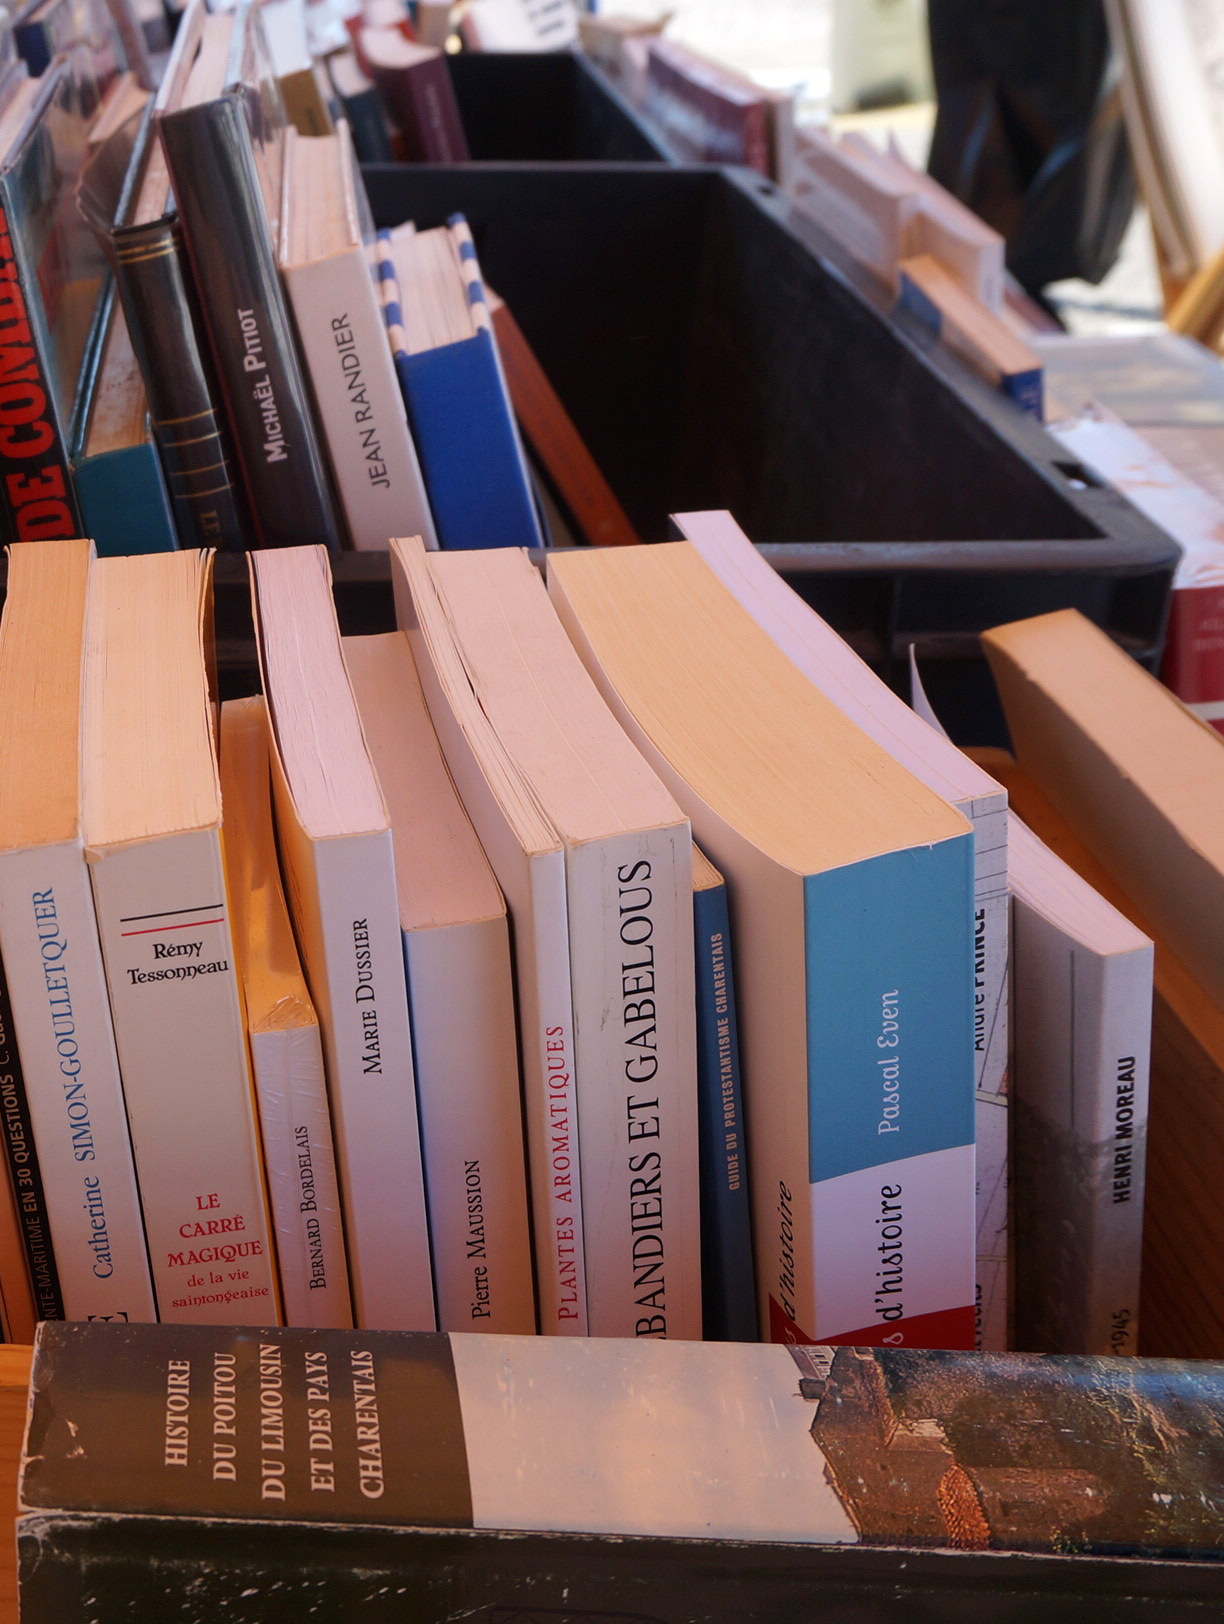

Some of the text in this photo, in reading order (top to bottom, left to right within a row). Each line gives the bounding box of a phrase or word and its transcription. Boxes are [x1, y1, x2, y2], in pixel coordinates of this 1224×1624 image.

[330, 312, 391, 489] JEAN RANDIER
[6, 464, 75, 542] DE
[126, 960, 229, 985] Tessonneau
[152, 941, 203, 960] Rémy
[352, 918, 383, 1075] MARIE DUSSIER
[32, 885, 96, 1163] SIMON-GOULLETQUER
[710, 932, 741, 1192] GUIDE DU PROTESTANTISME CHARENTAIS
[877, 989, 901, 1136] Pascal Even
[617, 859, 667, 1340] BANDIERS ET GABELOUS
[1112, 1056, 1136, 1204] HENRI MOREAU
[16, 1168, 34, 1187] 30
[21, 1191, 38, 1213] EN
[78, 1174, 115, 1280] Catherine
[179, 1214, 246, 1239] CARRÉ
[196, 1193, 221, 1211] LE
[294, 1125, 327, 1291] BERNARD BORDELAIS
[464, 1159, 492, 1320] Pierre MAUSSION
[546, 1024, 580, 1321] PLANTES AROMATIQUES
[25, 1215, 58, 1321] NTE-MARITIME
[167, 1240, 263, 1268] MAGIQUE
[172, 1286, 269, 1308] saintongeaise
[187, 1269, 250, 1288] de la vie
[775, 1180, 796, 1322] d'histoire
[875, 1183, 904, 1322] d'histoire
[164, 1359, 191, 1468] HISTOIRE
[213, 1352, 237, 1483] DU POITOU
[259, 1343, 286, 1501] DU LIMOUSIN
[304, 1351, 336, 1493] ET DES PAYS
[350, 1350, 385, 1500] CHARENTAIS
